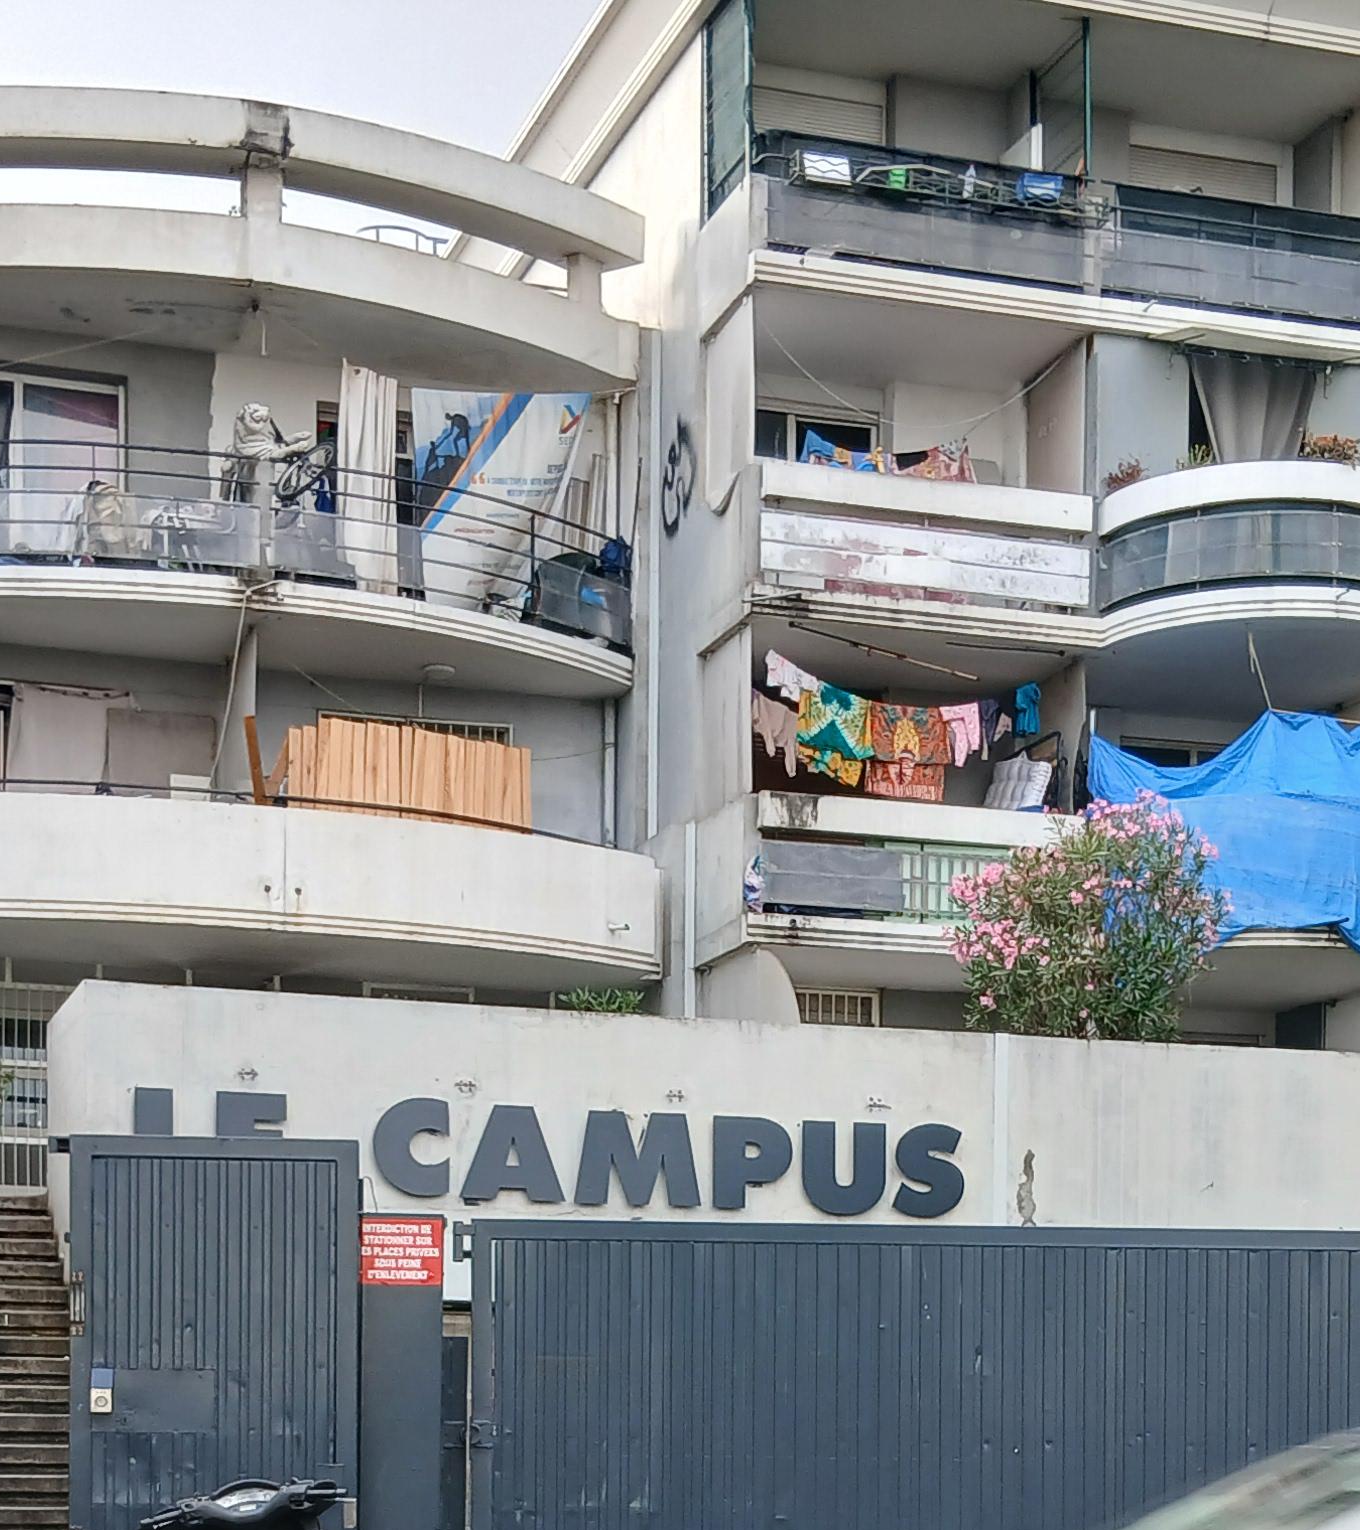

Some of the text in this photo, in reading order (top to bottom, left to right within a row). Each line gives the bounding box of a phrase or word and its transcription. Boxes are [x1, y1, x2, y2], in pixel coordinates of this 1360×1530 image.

[373, 1097, 965, 1218] CAMPUS
[363, 1235, 433, 1246] STATIONNER SUR
[361, 1246, 372, 1256] ES
[373, 1247, 404, 1257] PLACES
[374, 1258, 422, 1269] SOUS PEINE
